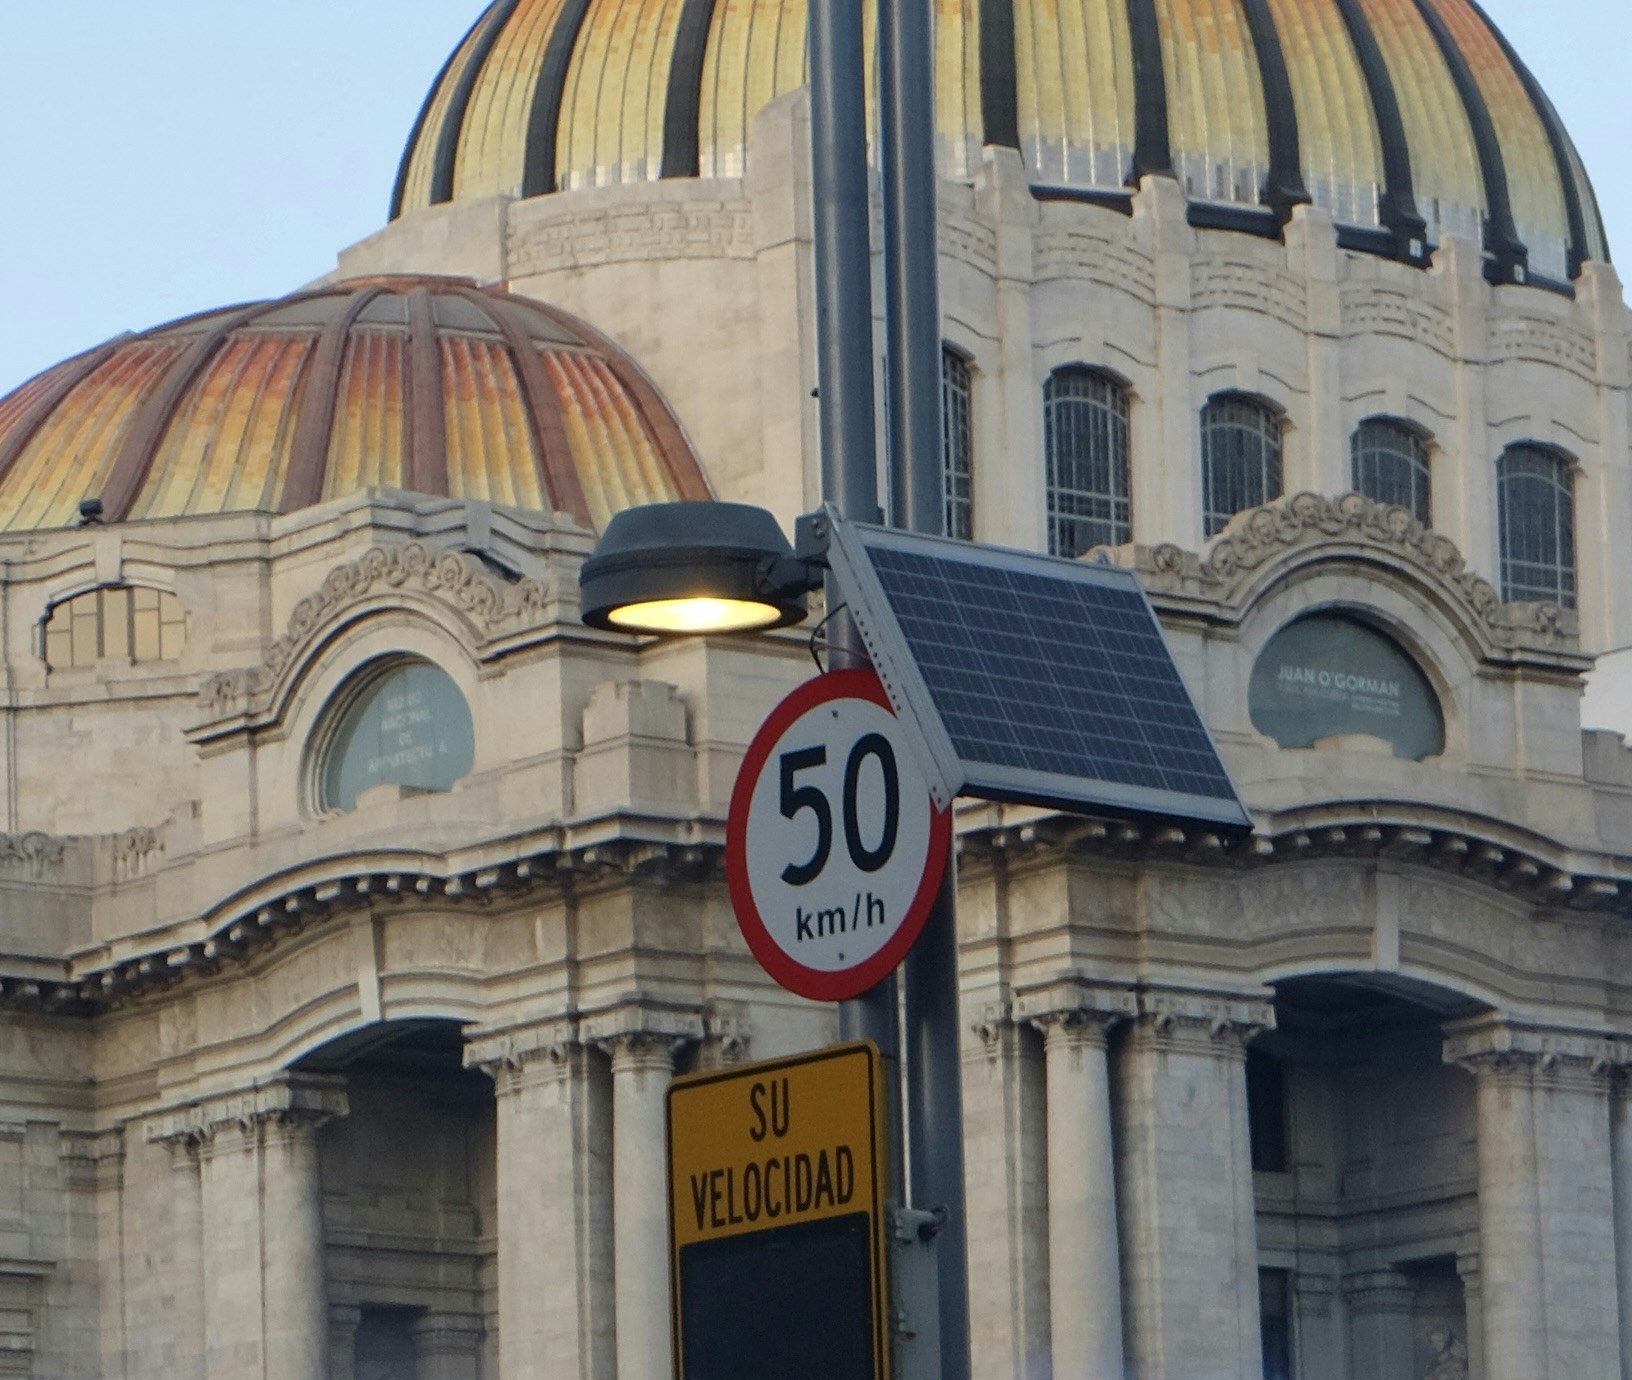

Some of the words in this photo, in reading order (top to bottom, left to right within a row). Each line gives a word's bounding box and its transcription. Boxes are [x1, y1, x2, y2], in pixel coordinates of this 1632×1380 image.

[1277, 664, 1314, 683] JUAN
[1318, 670, 1399, 697] O'GORMAN
[779, 732, 900, 886] 50
[796, 892, 885, 942] km/h
[749, 1077, 789, 1142] SU
[690, 1145, 854, 1231] VELOCIDAD
